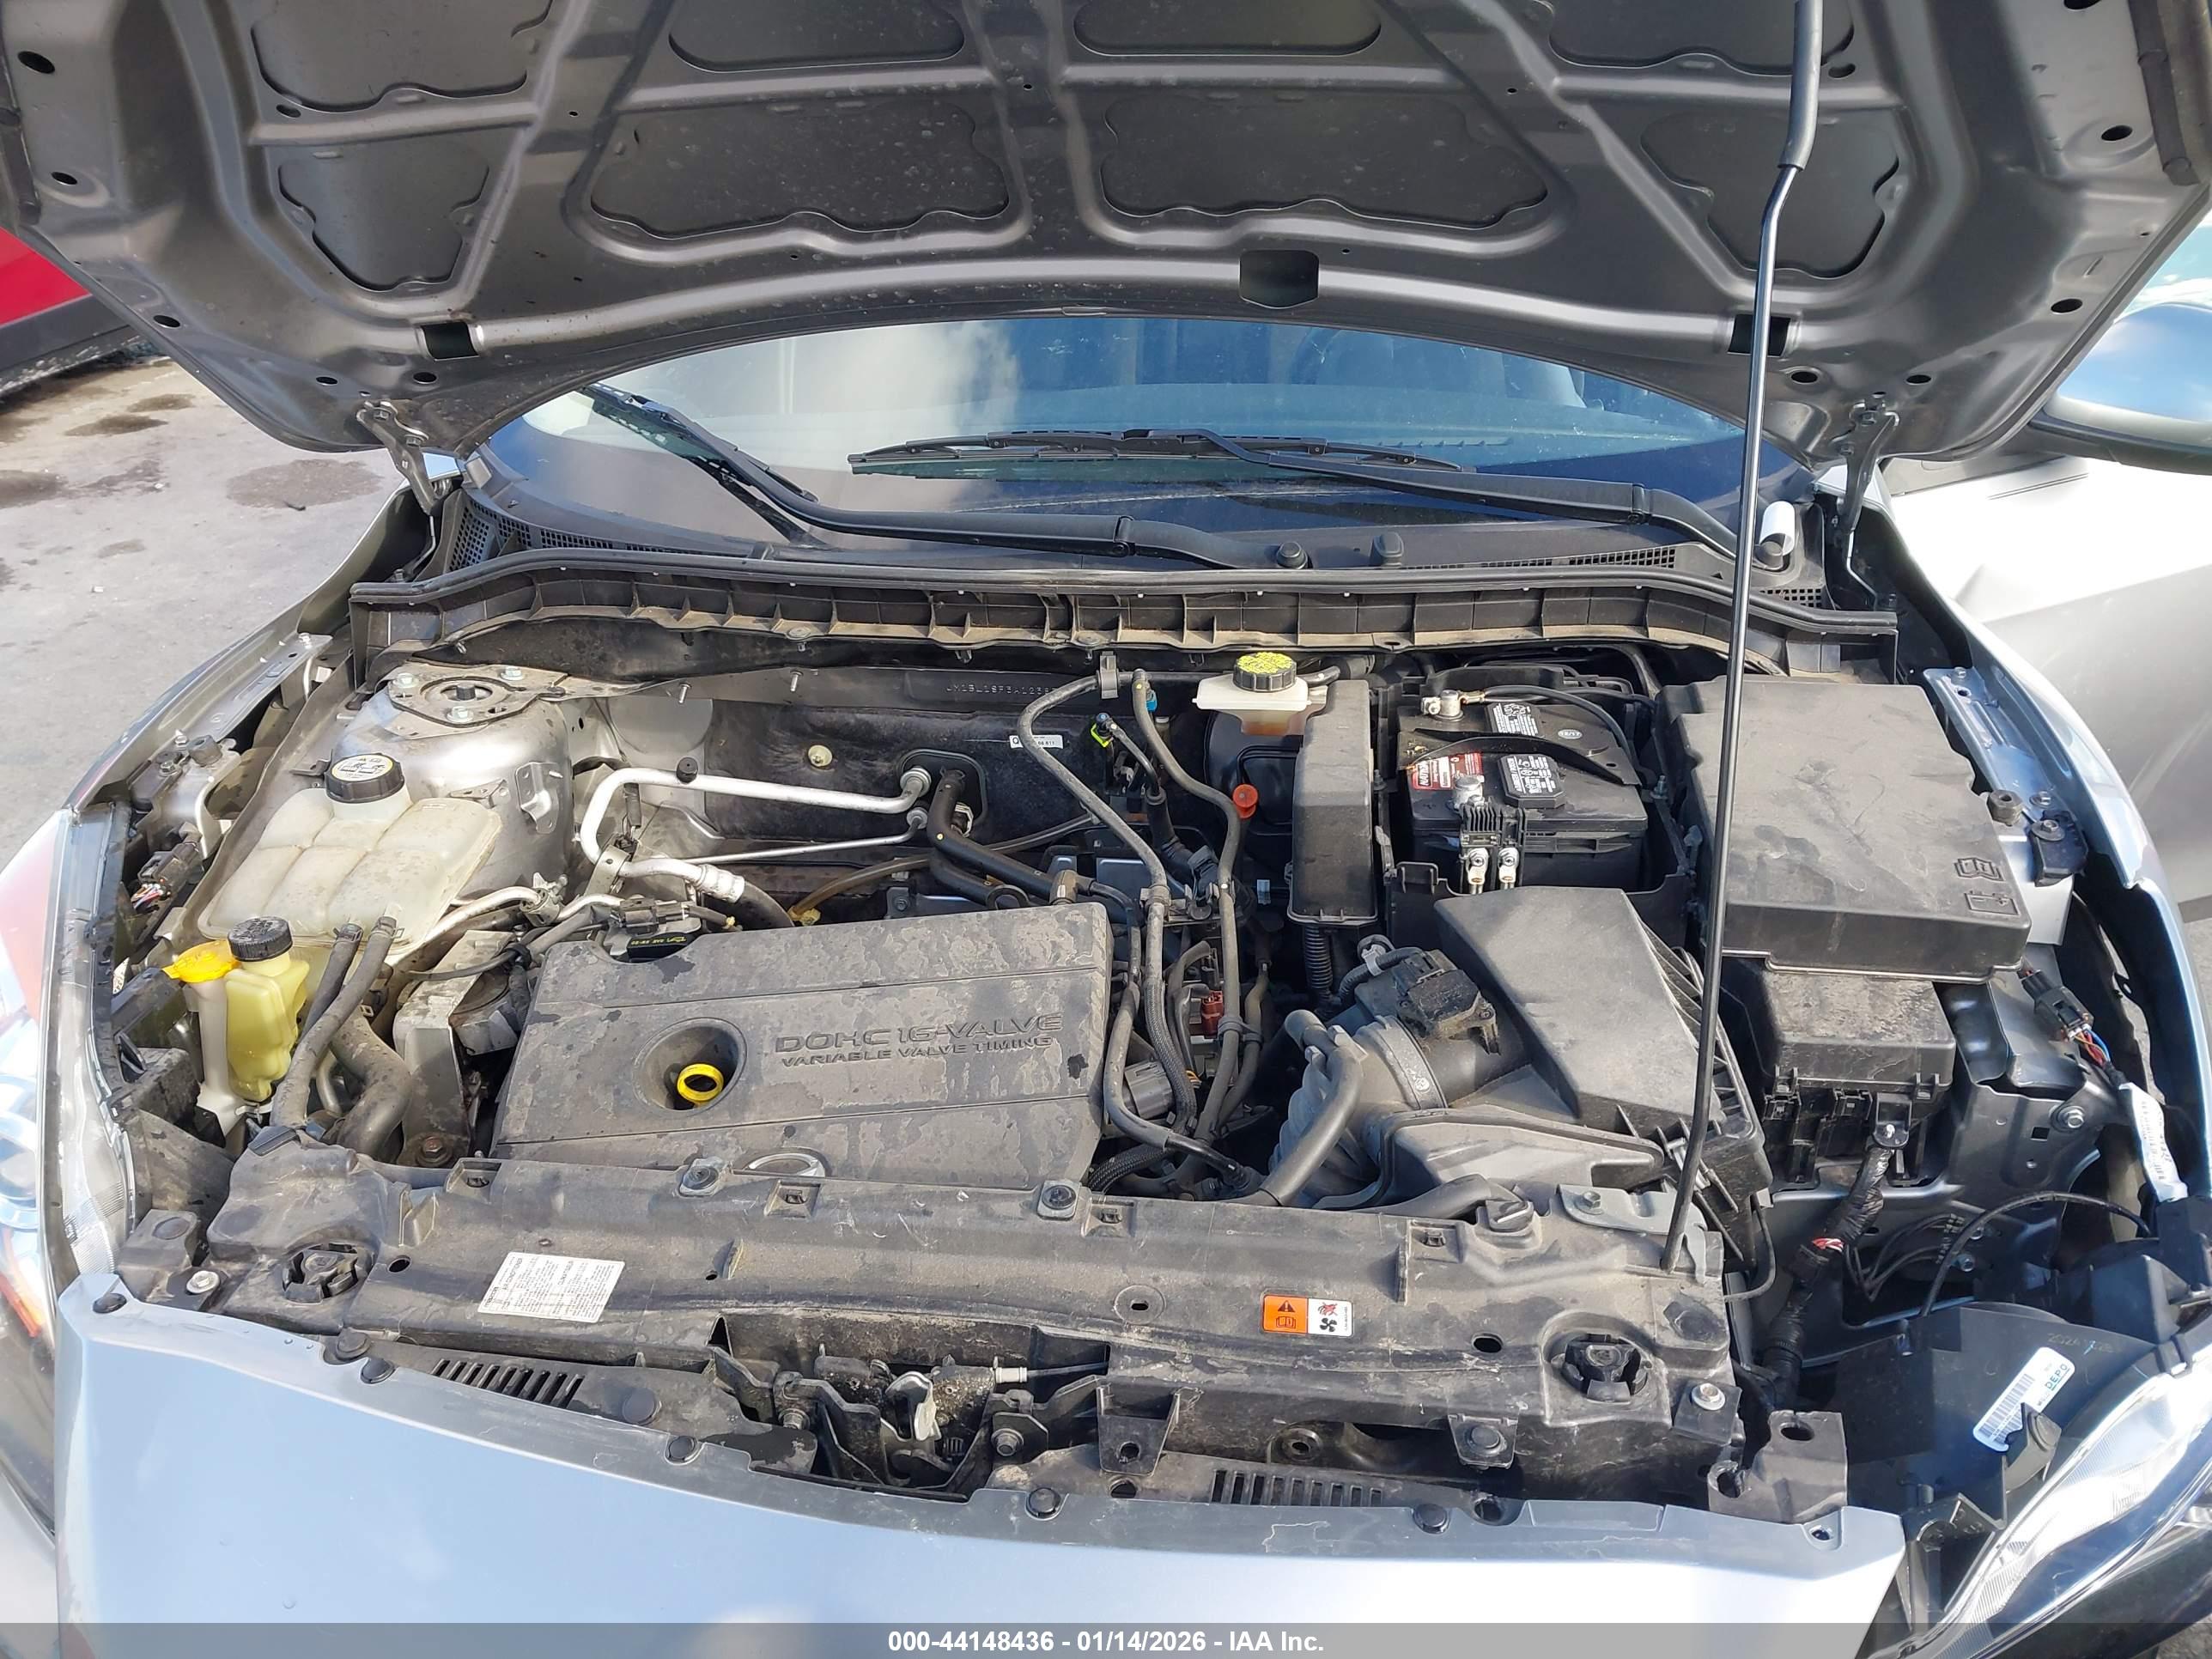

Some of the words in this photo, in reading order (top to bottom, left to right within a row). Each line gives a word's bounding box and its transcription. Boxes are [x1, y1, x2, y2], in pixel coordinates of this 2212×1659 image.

[775, 1030, 890, 1053] DOHC
[898, 1012, 1062, 1044] 16-VALVE
[781, 1049, 892, 1067] VARIABLE
[897, 1042, 968, 1059] VALVE
[972, 1036, 1054, 1054] TIMING
[2045, 1364, 2068, 1389] DEPO
